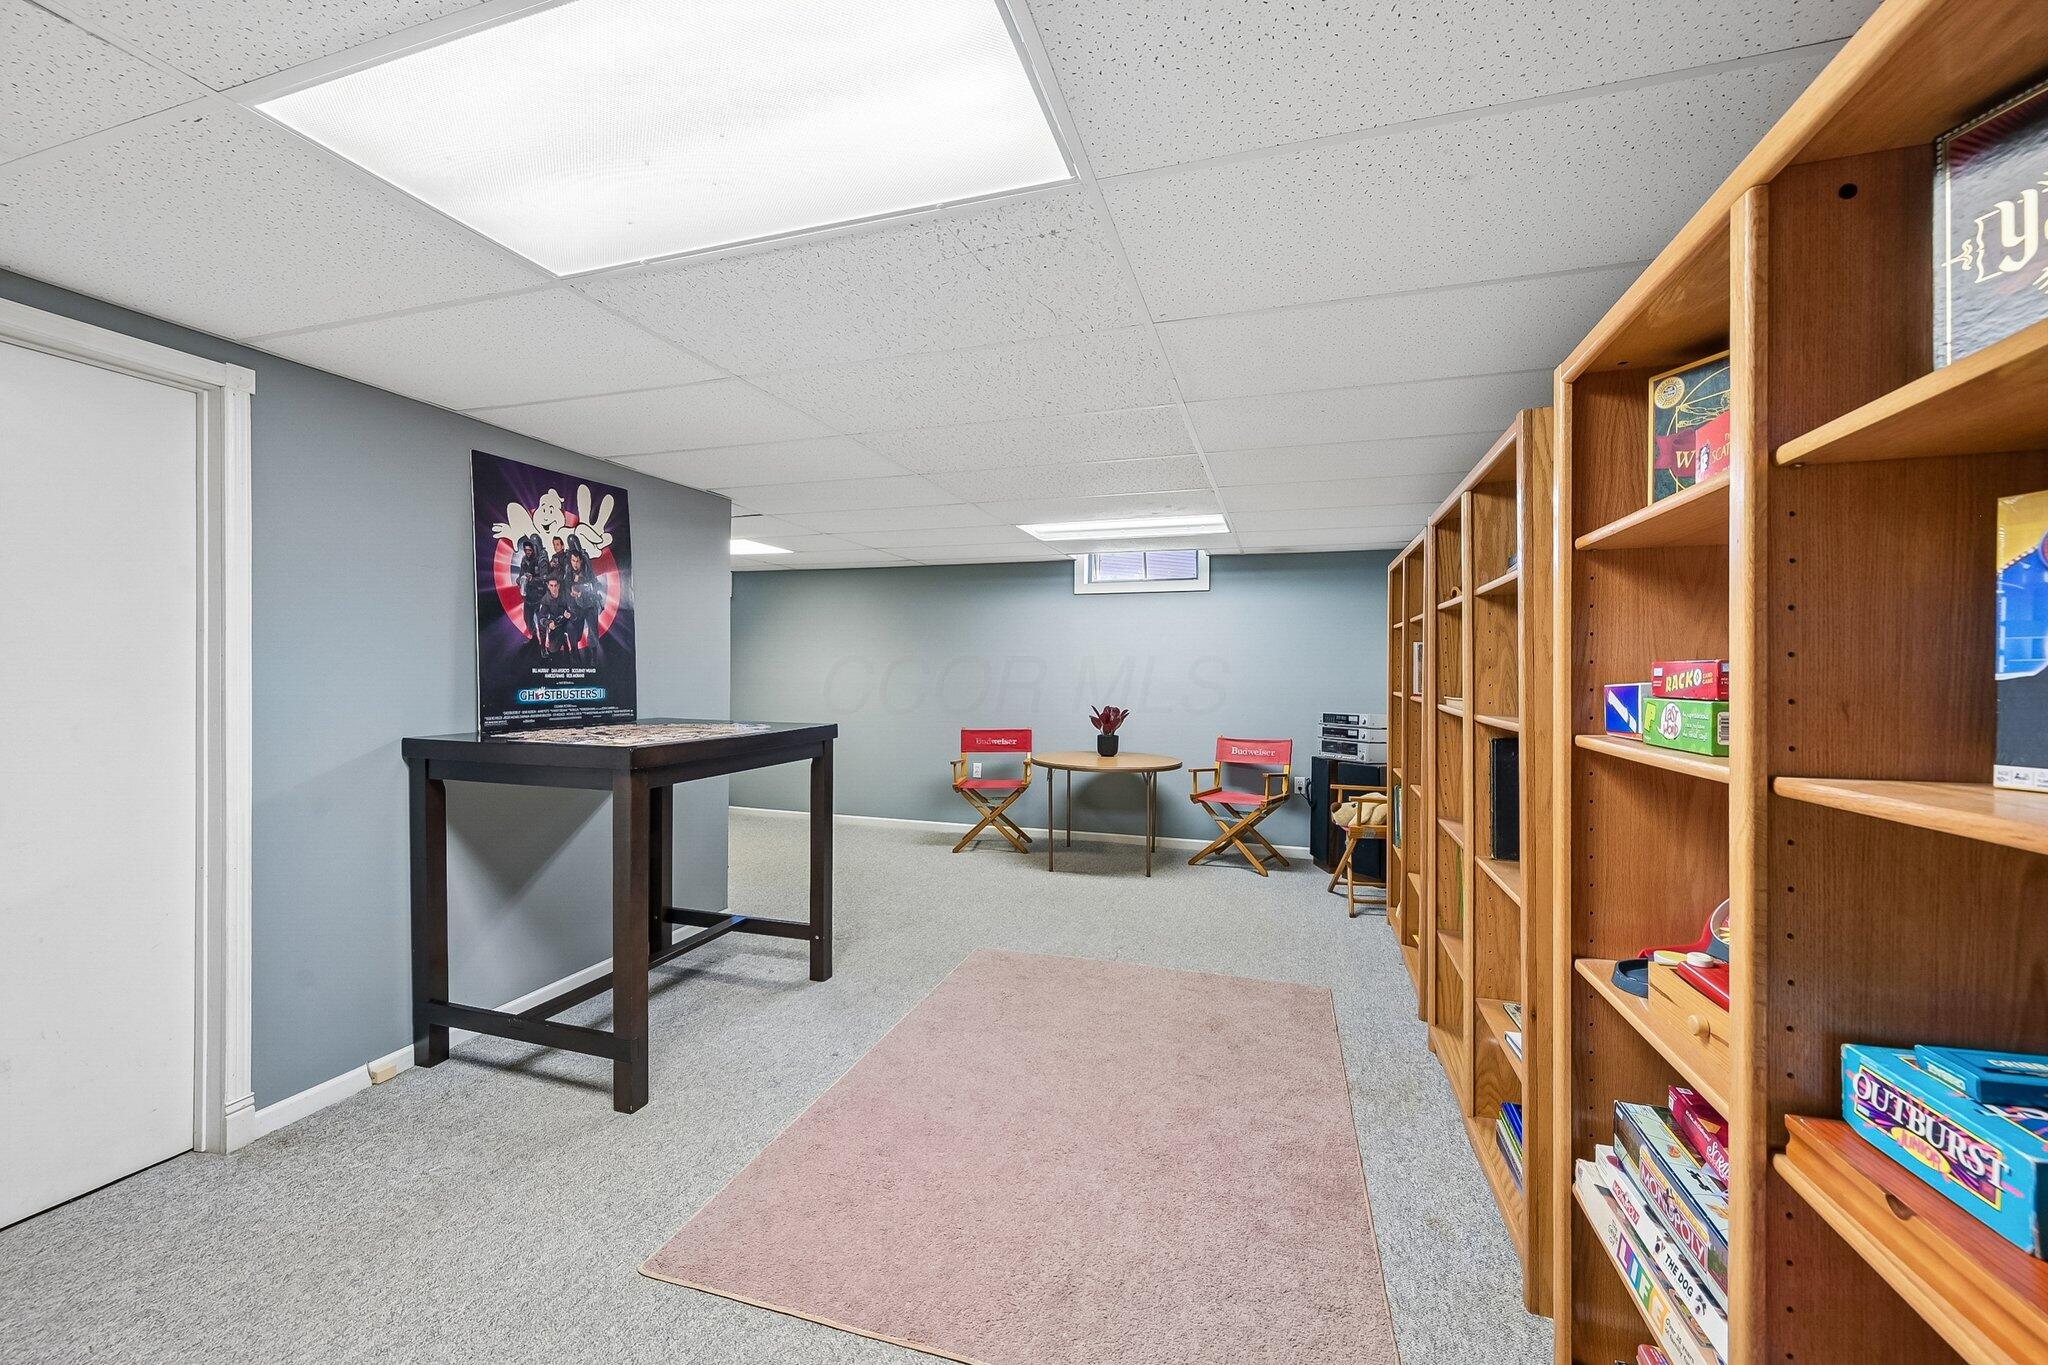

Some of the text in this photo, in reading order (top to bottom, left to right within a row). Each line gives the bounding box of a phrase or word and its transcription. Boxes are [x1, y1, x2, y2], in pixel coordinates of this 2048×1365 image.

[519, 688, 597, 701] GHOSTBUSTERS
[1231, 746, 1276, 757] Budweiser
[1852, 1073, 2010, 1191] OUTBURST
[1641, 1161, 1704, 1259] MONOPOLY
[1618, 1236, 1665, 1322] LIFE
[1664, 1253, 1694, 1298] THE DOG
